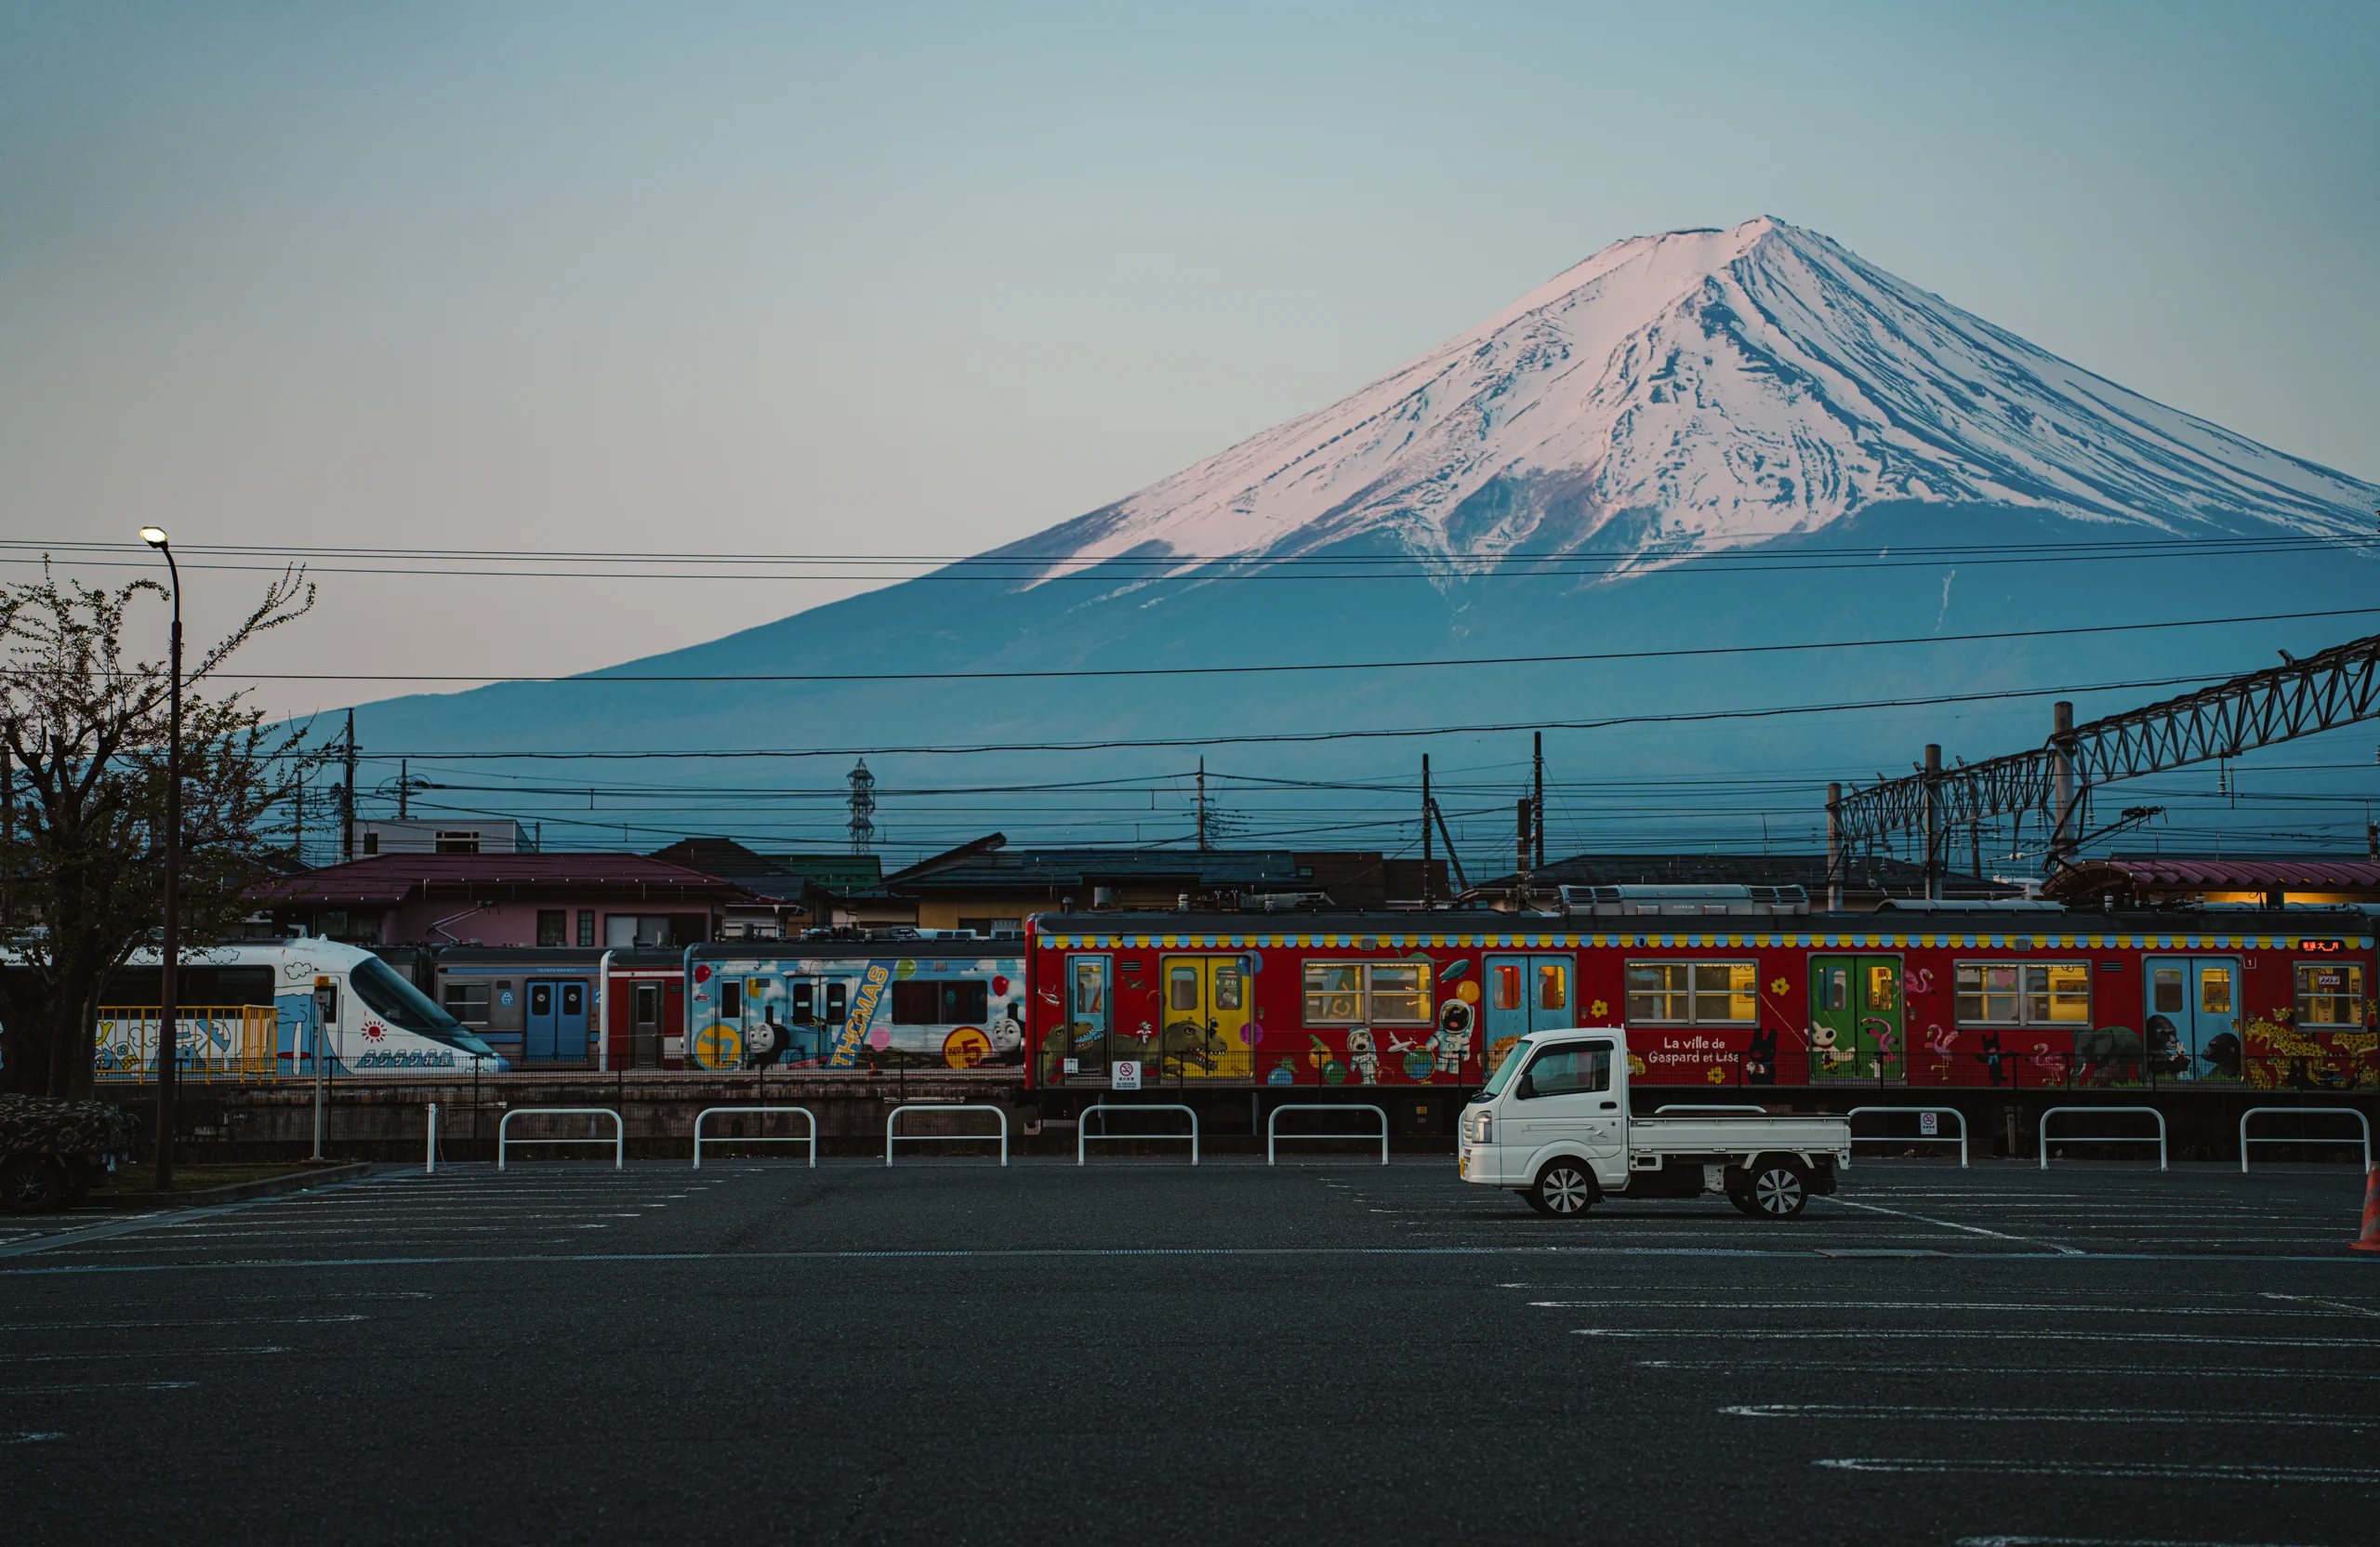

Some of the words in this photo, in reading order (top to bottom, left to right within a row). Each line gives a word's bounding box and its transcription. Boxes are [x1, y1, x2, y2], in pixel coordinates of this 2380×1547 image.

[595, 990, 602, 1003] 2
[830, 965, 889, 1066] THOMAS
[719, 1038, 734, 1062] 7
[961, 1038, 982, 1064] 5
[1663, 1037, 1680, 1049] La
[1683, 1036, 1710, 1049] ville
[1712, 1038, 1726, 1049] de
[1648, 1050, 1700, 1066] Gaspard
[1702, 1052, 1713, 1063] et
[1715, 1051, 1739, 1063] Lisa
